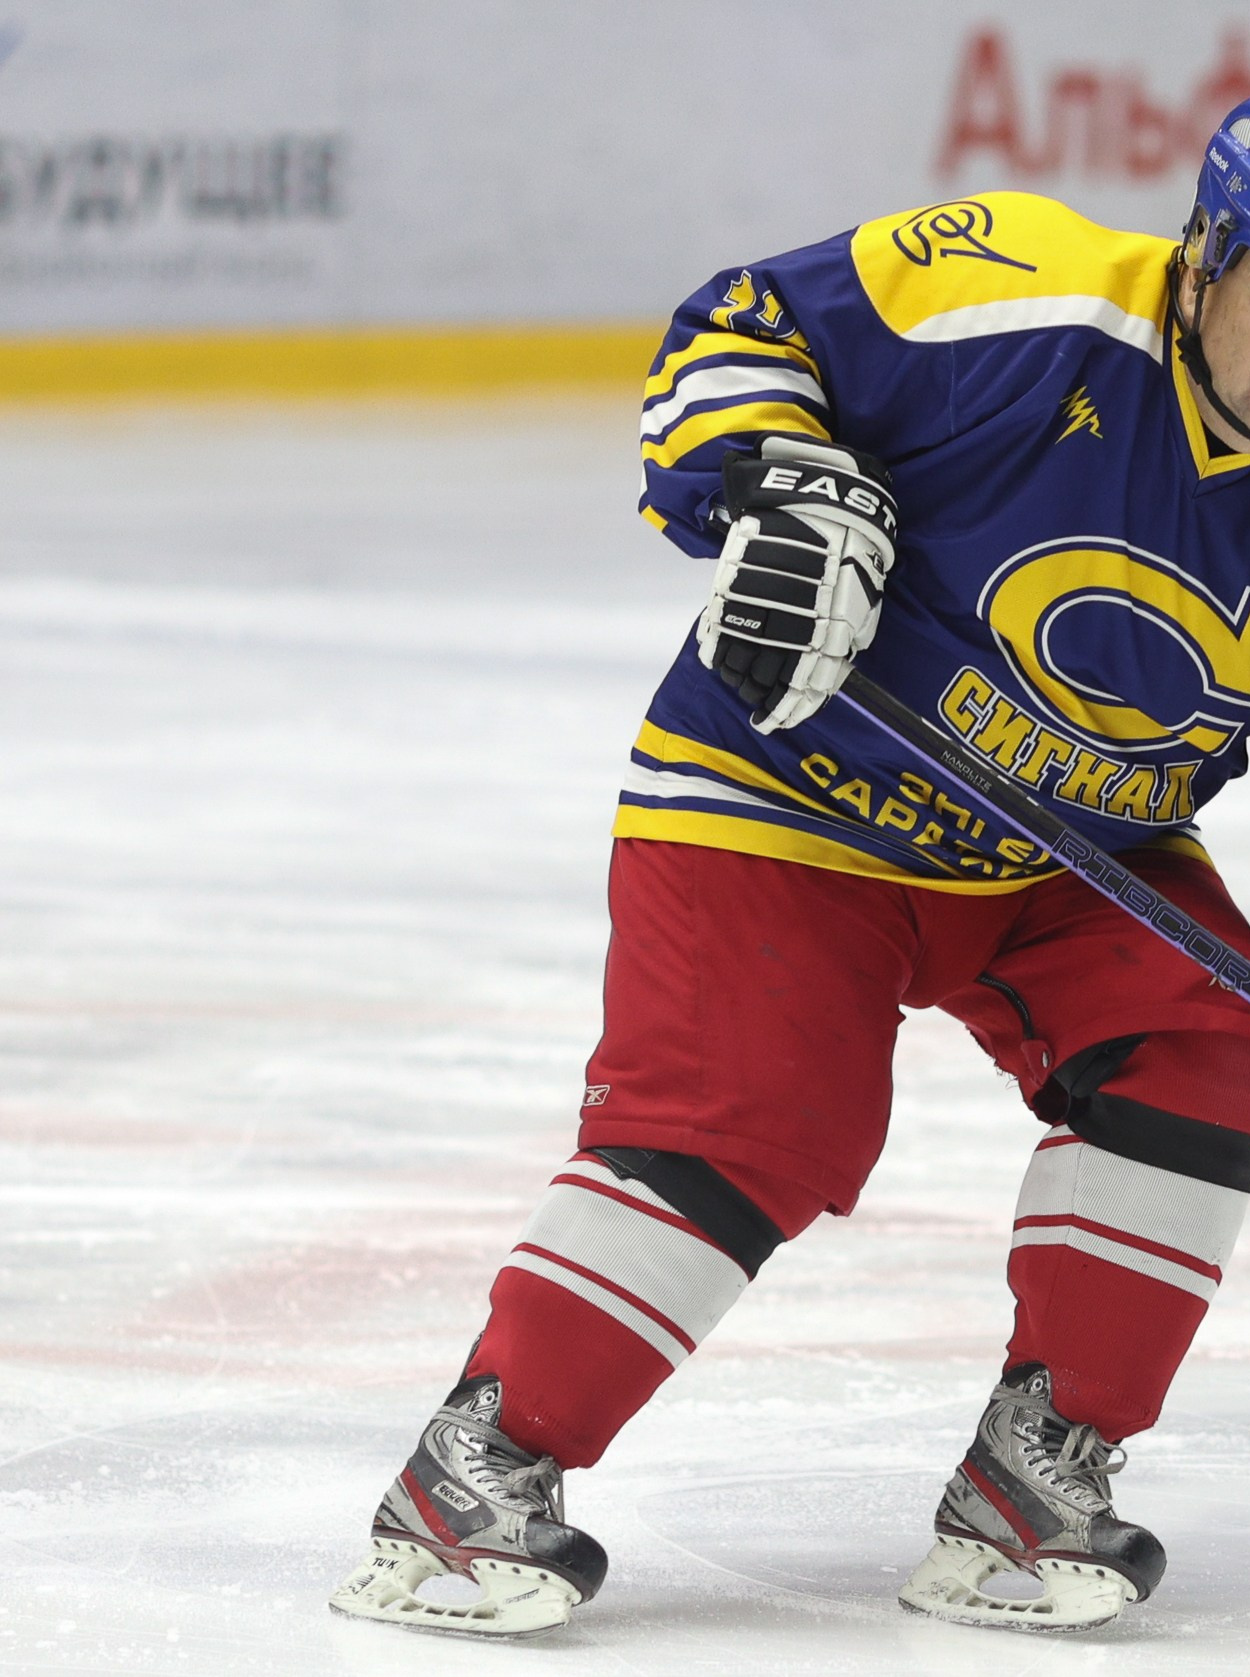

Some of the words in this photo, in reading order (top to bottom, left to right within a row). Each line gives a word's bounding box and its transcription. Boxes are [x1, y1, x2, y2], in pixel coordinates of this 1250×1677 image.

[760, 466, 898, 540] EAST
[939, 666, 1203, 826] СИГНАЛ
[940, 750, 992, 791] NANOLITE
